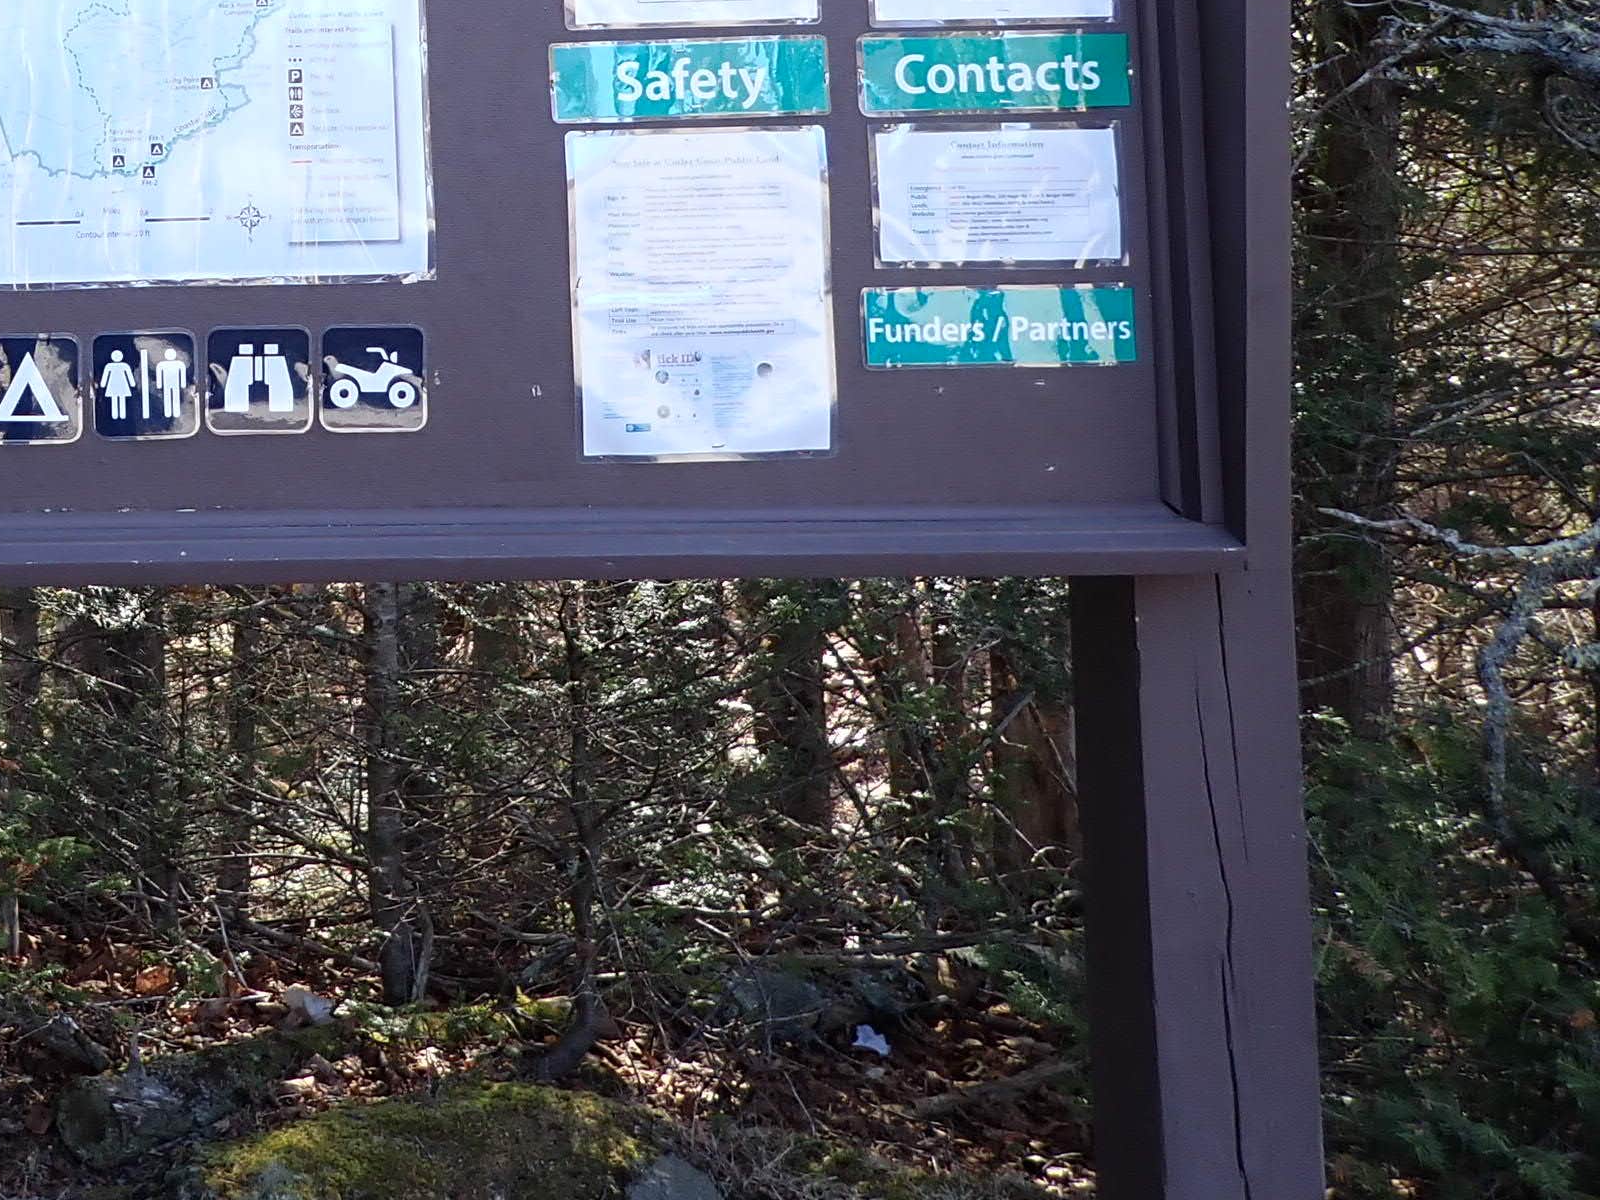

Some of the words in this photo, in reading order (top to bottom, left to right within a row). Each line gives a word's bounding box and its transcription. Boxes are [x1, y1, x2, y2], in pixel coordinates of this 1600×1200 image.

[616, 57, 768, 109] Safety
[895, 53, 1101, 95] Contacts
[869, 315, 985, 343] Funders
[992, 315, 1006, 343] /
[1011, 315, 1132, 342] Partners
